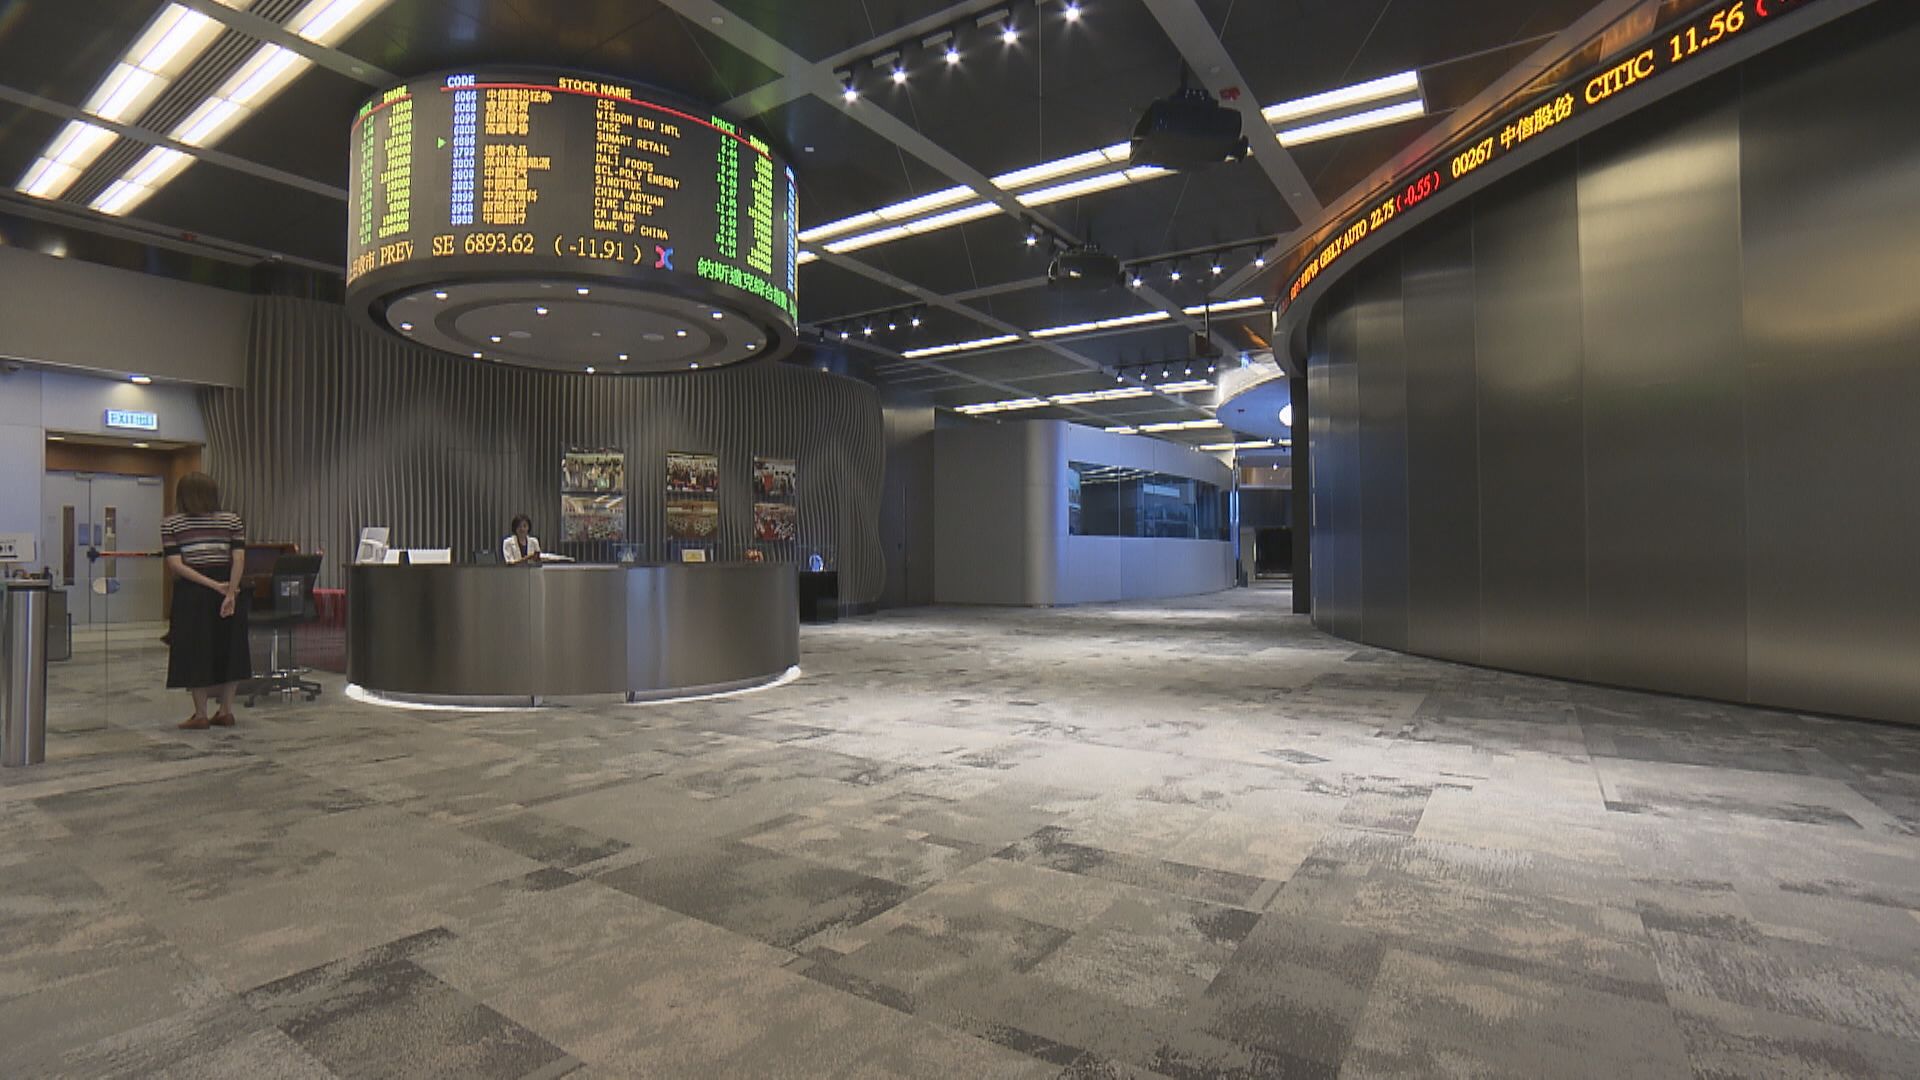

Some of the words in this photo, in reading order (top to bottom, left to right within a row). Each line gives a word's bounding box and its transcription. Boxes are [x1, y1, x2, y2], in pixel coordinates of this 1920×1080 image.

[1585, 49, 1655, 104] CITIC
[1670, 1, 1745, 62] 11.56
[447, 75, 475, 88] CODE
[559, 77, 597, 93] STOCK
[600, 84, 632, 100] NAME
[598, 100, 616, 110] CSC
[638, 117, 654, 130] EDU
[660, 123, 680, 138] INTL
[1500, 93, 1574, 150] 中信股份
[596, 132, 632, 146] SUNART
[637, 140, 670, 156] RETAIL
[625, 157, 653, 172] FOODS
[1452, 137, 1494, 178] 00267
[596, 175, 642, 191] SINOTRUK
[595, 187, 624, 200] CHINA
[630, 191, 664, 208] AOYUAN
[624, 201, 652, 215] ENRIC
[612, 211, 635, 222] BANK
[594, 219, 617, 231] BANK
[624, 223, 635, 233] OF
[640, 225, 668, 240] CHINA
[1320, 238, 1344, 268] GEELY
[1343, 219, 1367, 250] AUTO
[1370, 197, 1394, 230] 22.75
[380, 240, 413, 266] PREV
[433, 235, 454, 256] SE
[464, 233, 534, 254] 6893.62
[111, 412, 133, 424] EXIT
